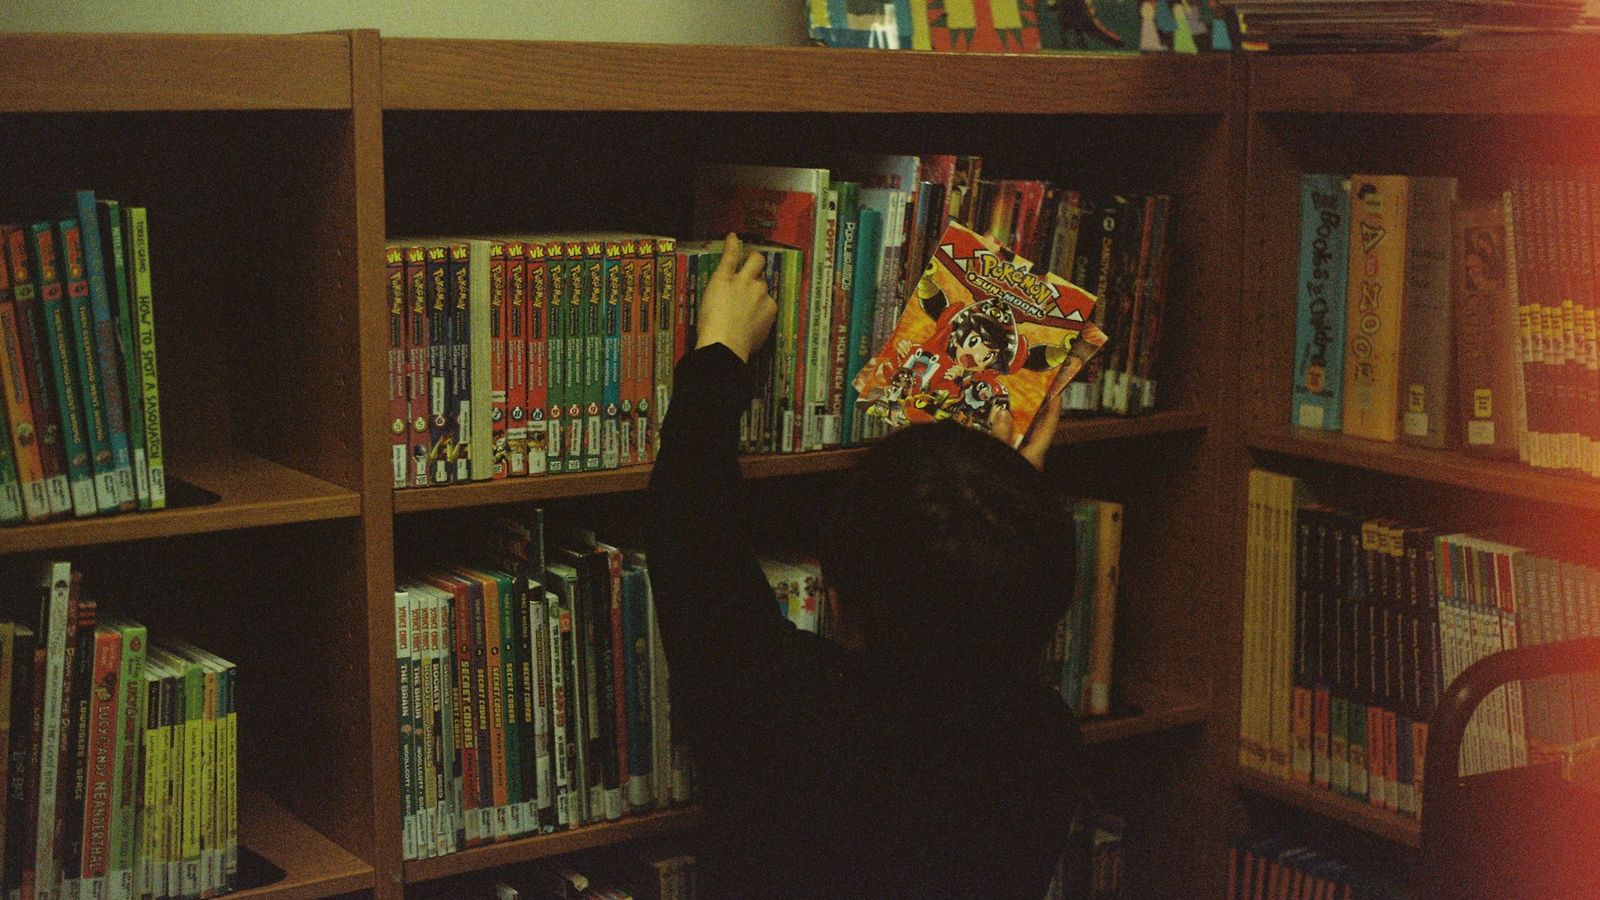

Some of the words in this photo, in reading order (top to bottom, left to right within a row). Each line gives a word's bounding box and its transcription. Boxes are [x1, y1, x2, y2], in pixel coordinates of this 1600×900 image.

[139, 295, 152, 324] HOW
[974, 277, 1001, 295] SUN
[1003, 293, 1038, 315] MOON
[142, 332, 152, 345] TO
[838, 324, 846, 333] A
[142, 349, 155, 377] SPOT
[835, 336, 846, 364] HOLE
[145, 382, 157, 392] A
[834, 367, 844, 390] NEW
[146, 395, 161, 459] SASQUATCH
[432, 663, 440, 712] ROCKETS
[461, 660, 472, 703] SECRET
[477, 668, 486, 698] SECRET
[493, 666, 501, 697] SECRET
[506, 662, 514, 691] SECRET
[522, 661, 531, 692] SECRET
[401, 685, 410, 717] BRAIN
[414, 688, 422, 719] BRAIN
[478, 700, 487, 731] CODERS
[494, 698, 502, 728] CODERS
[507, 693, 515, 724] CODERS
[524, 693, 532, 723] CODERS
[97, 705, 110, 734] LUCY
[462, 705, 473, 748] CODERS
[95, 747, 108, 776] ANDY
[89, 781, 108, 870] NEANDERTHAL
